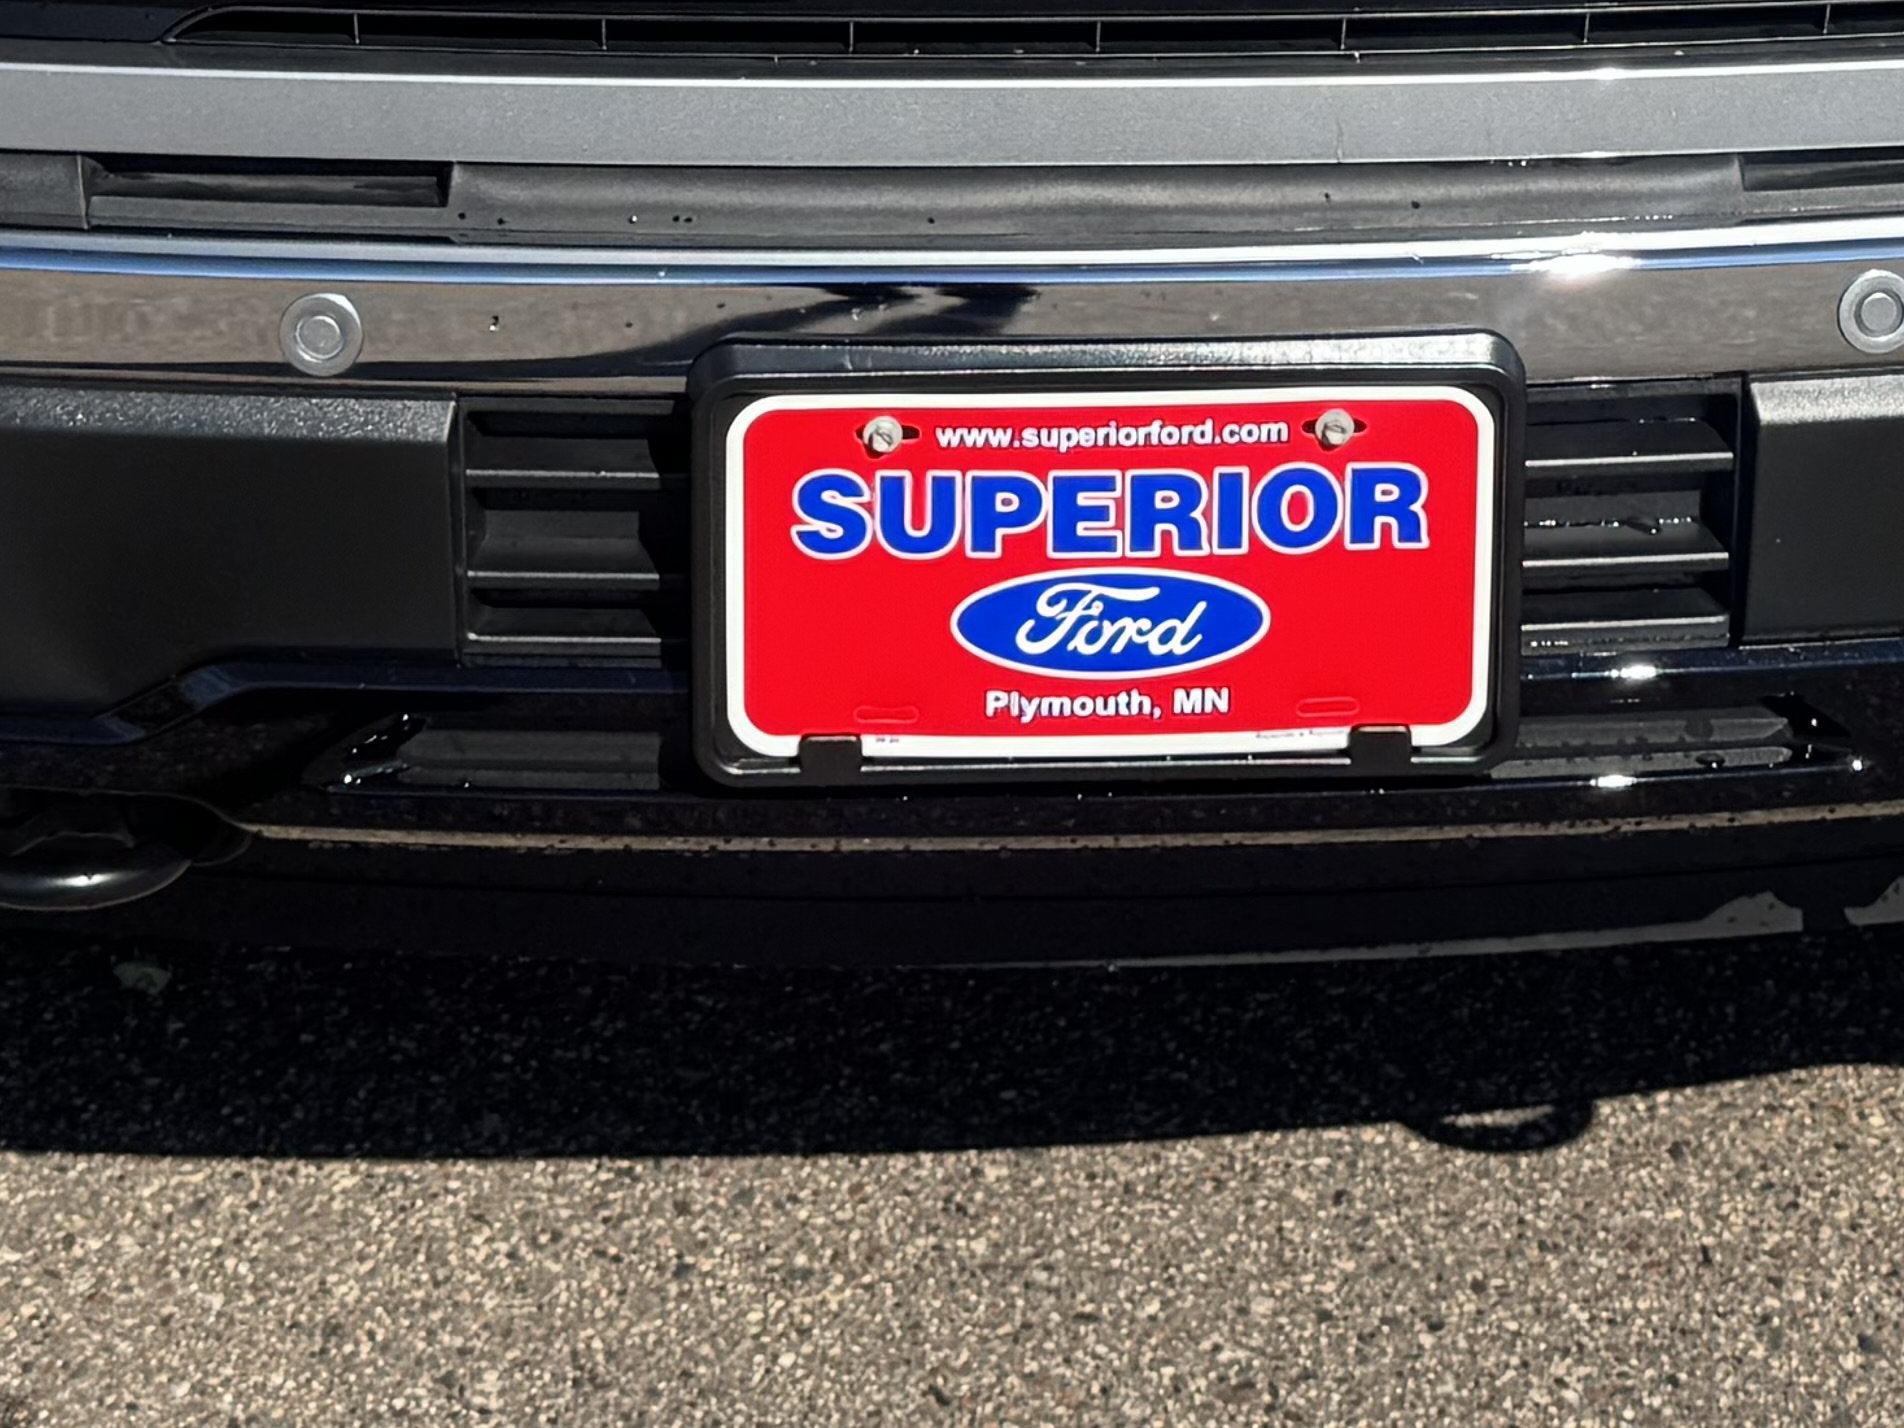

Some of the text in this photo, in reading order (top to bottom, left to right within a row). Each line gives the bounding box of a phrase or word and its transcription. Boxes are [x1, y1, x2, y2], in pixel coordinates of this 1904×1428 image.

[935, 419, 1289, 453] www.superiorford.com
[791, 461, 1430, 560] SUPERIOR
[1015, 582, 1208, 656] Ford
[985, 687, 1230, 724] Plymouth, MN
